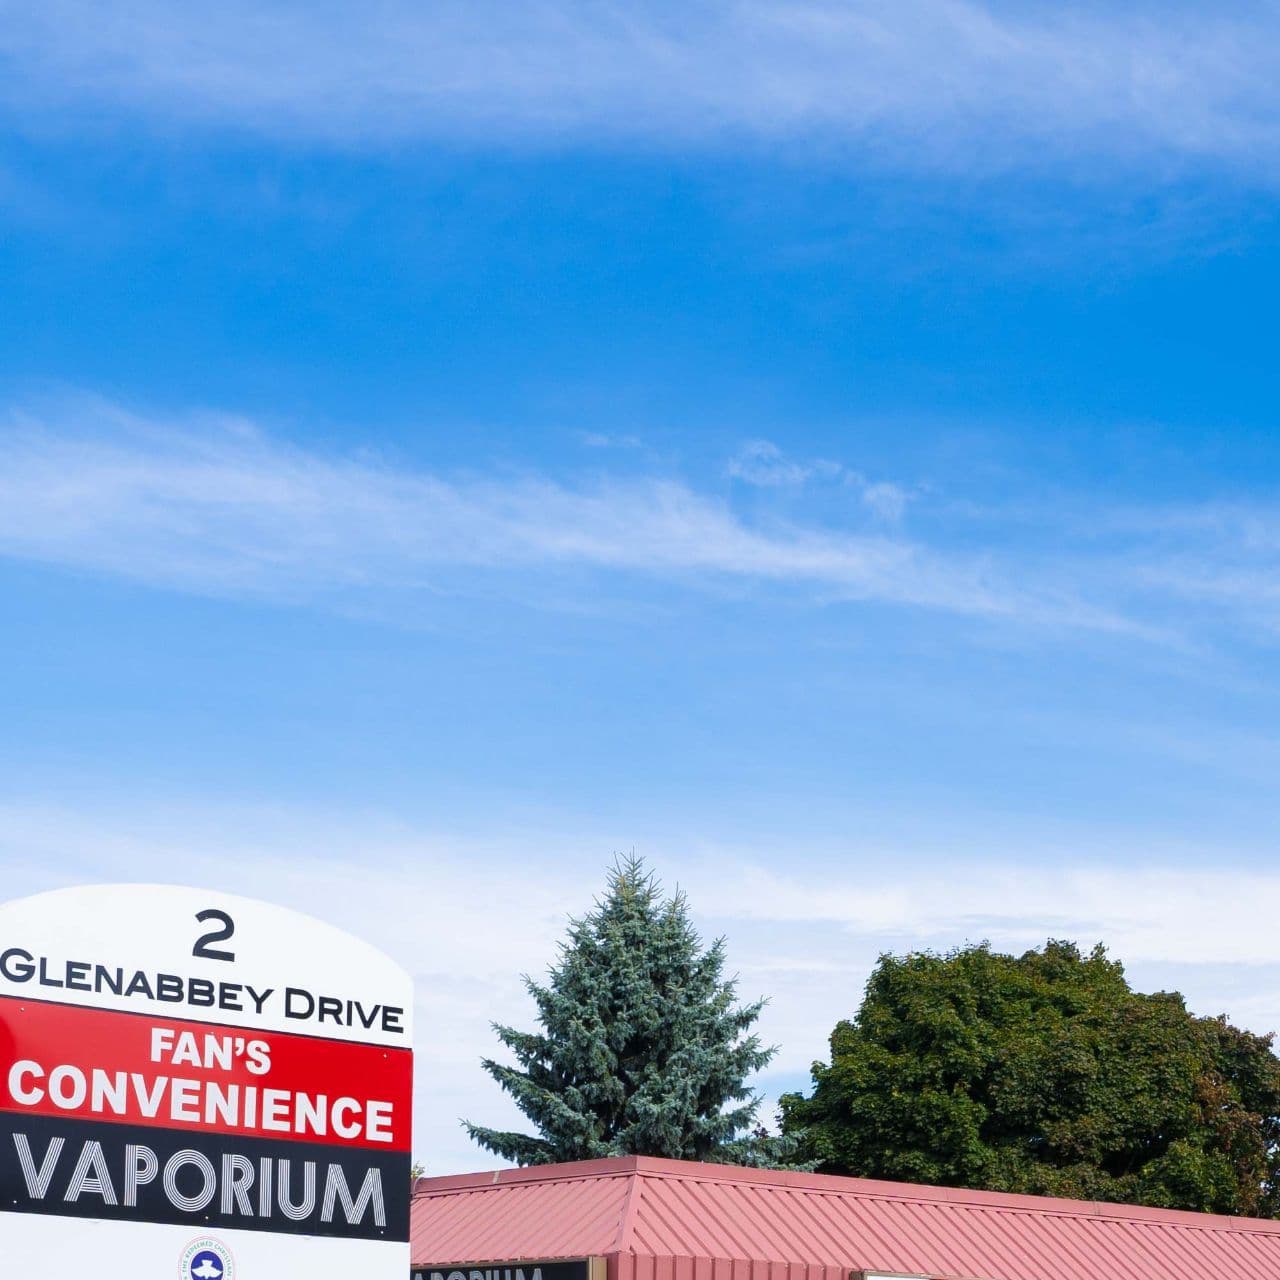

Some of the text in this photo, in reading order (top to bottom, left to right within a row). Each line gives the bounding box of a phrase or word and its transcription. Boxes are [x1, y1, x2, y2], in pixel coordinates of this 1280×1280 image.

[192, 909, 235, 962] 2
[0, 948, 404, 1034] GLENABBEY DRIVE
[150, 1027, 271, 1075] FAN'S
[7, 1060, 394, 1143] CONVENIENCE
[12, 1133, 387, 1227] VAPORIUM
